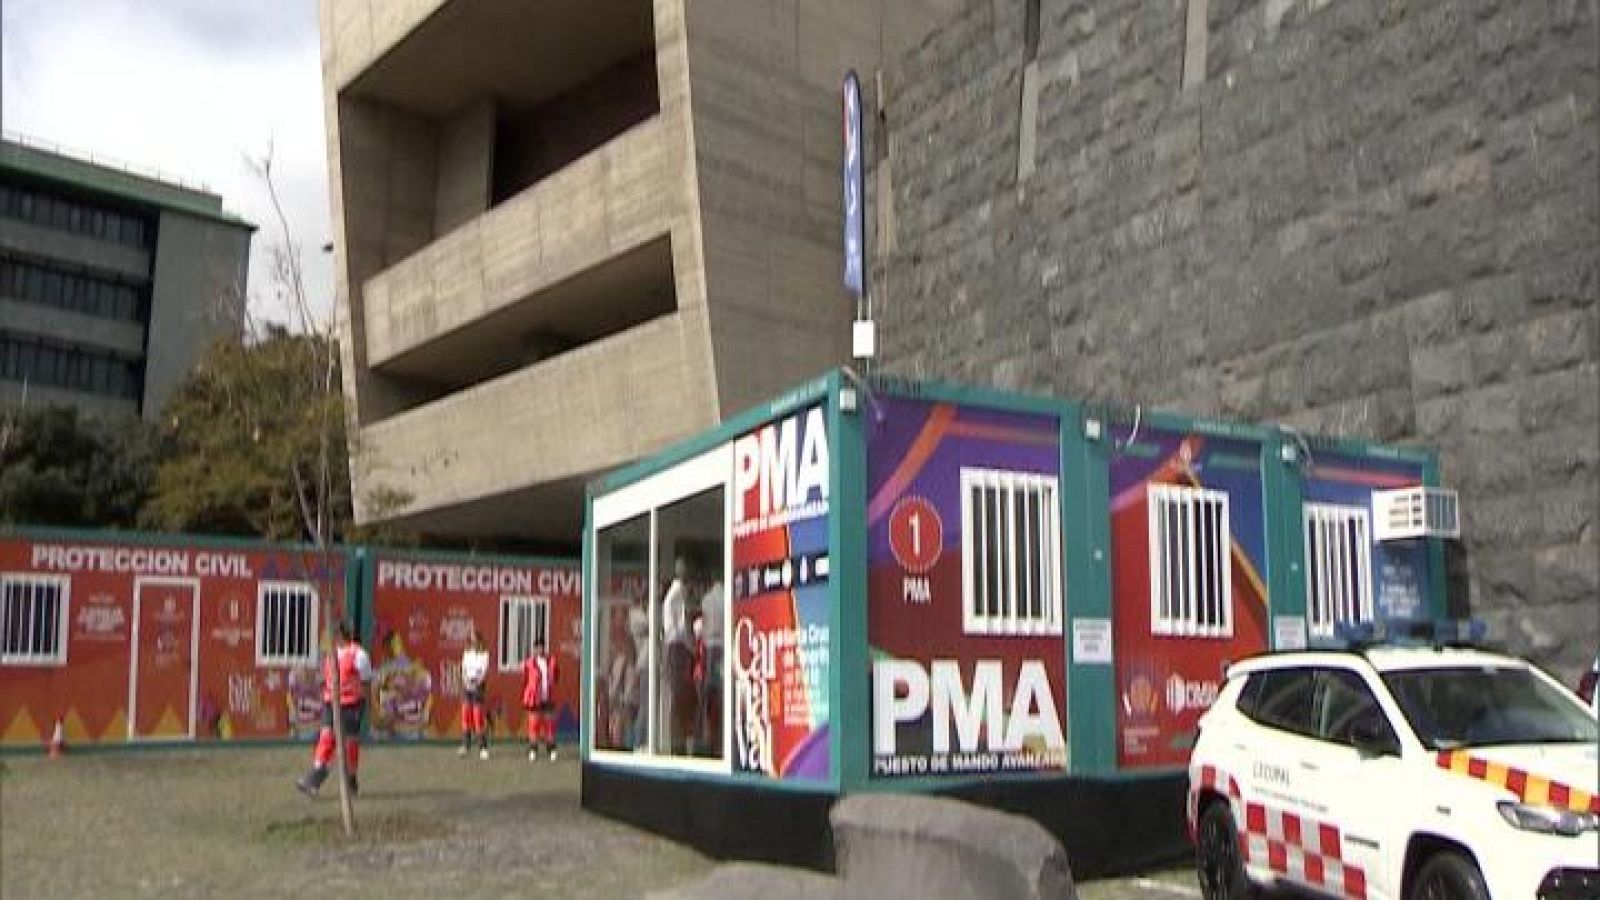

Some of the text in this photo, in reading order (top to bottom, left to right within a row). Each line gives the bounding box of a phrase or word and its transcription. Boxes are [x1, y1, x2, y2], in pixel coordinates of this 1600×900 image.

[735, 407, 829, 523] PMA
[908, 511, 922, 556] 1
[32, 543, 252, 578] PROTECCION CIVIL
[378, 560, 581, 596] PROTECCION CIVI
[904, 577, 932, 604] PMA
[873, 659, 1067, 753] PMA
